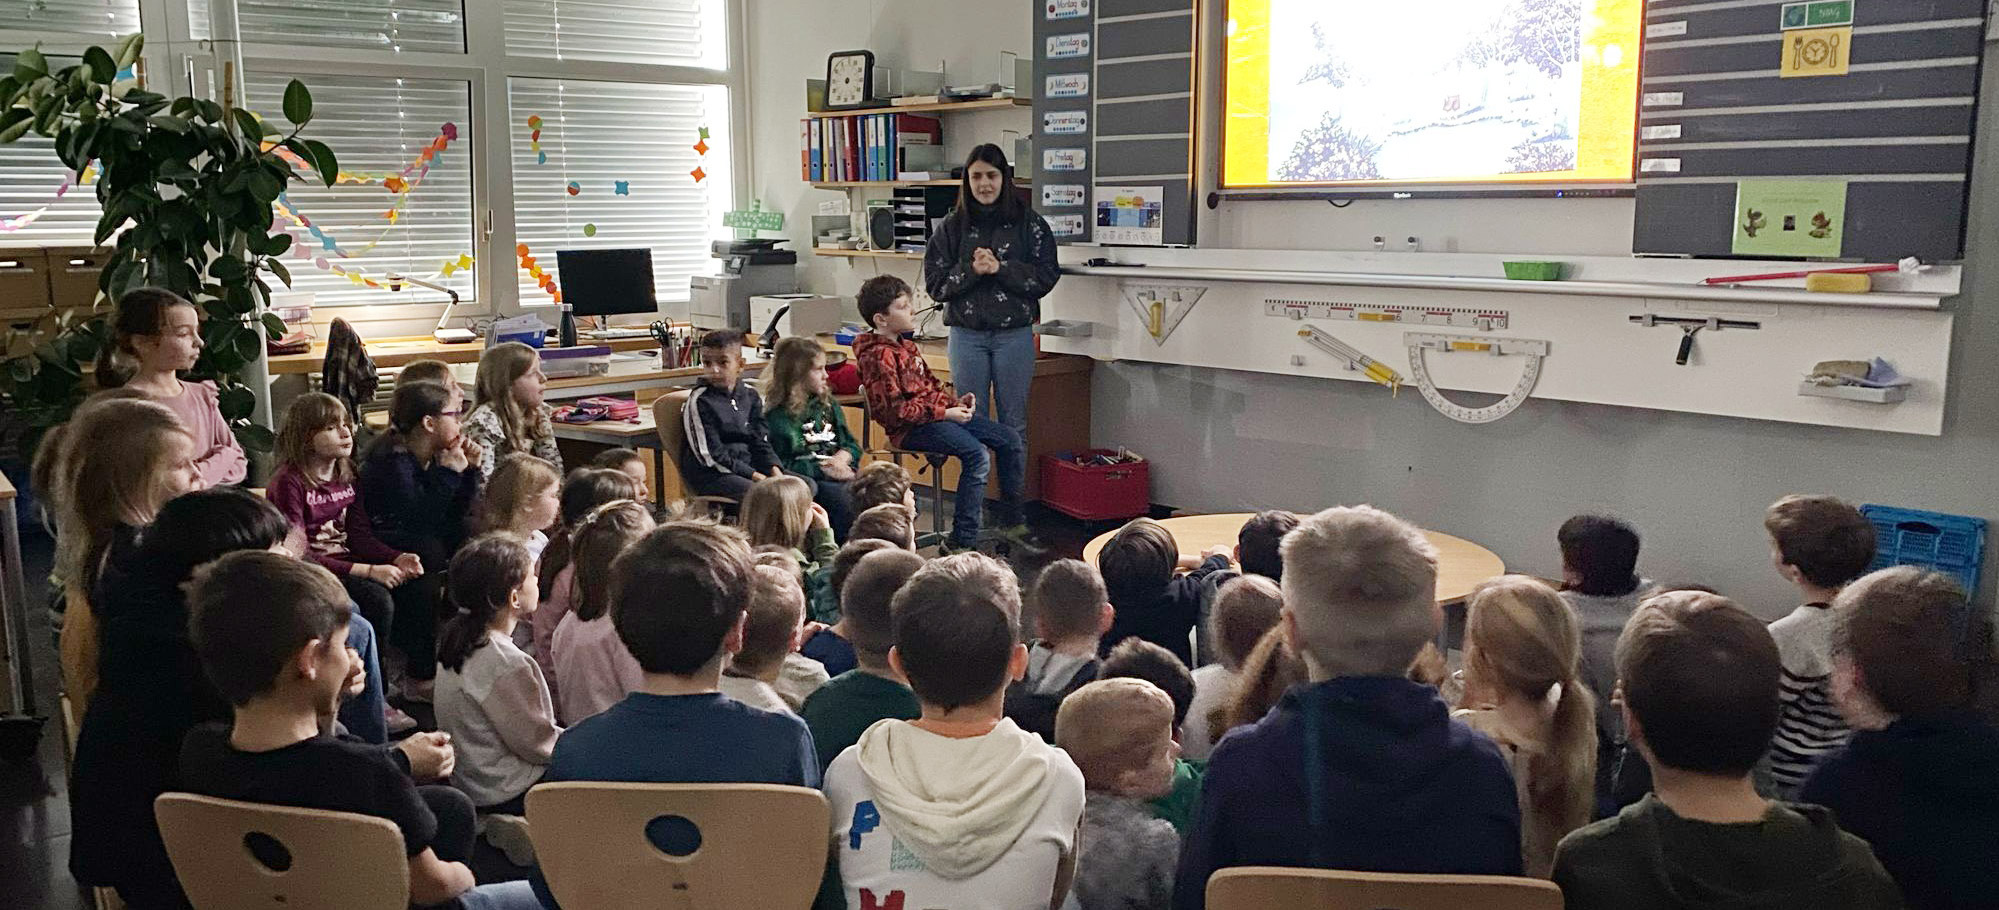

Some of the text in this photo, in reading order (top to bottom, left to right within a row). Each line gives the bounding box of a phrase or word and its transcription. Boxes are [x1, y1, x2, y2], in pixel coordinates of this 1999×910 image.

[1420, 314, 1426, 322] 7
[1472, 317, 1478, 326] 9
[1496, 318, 1505, 328] 10
